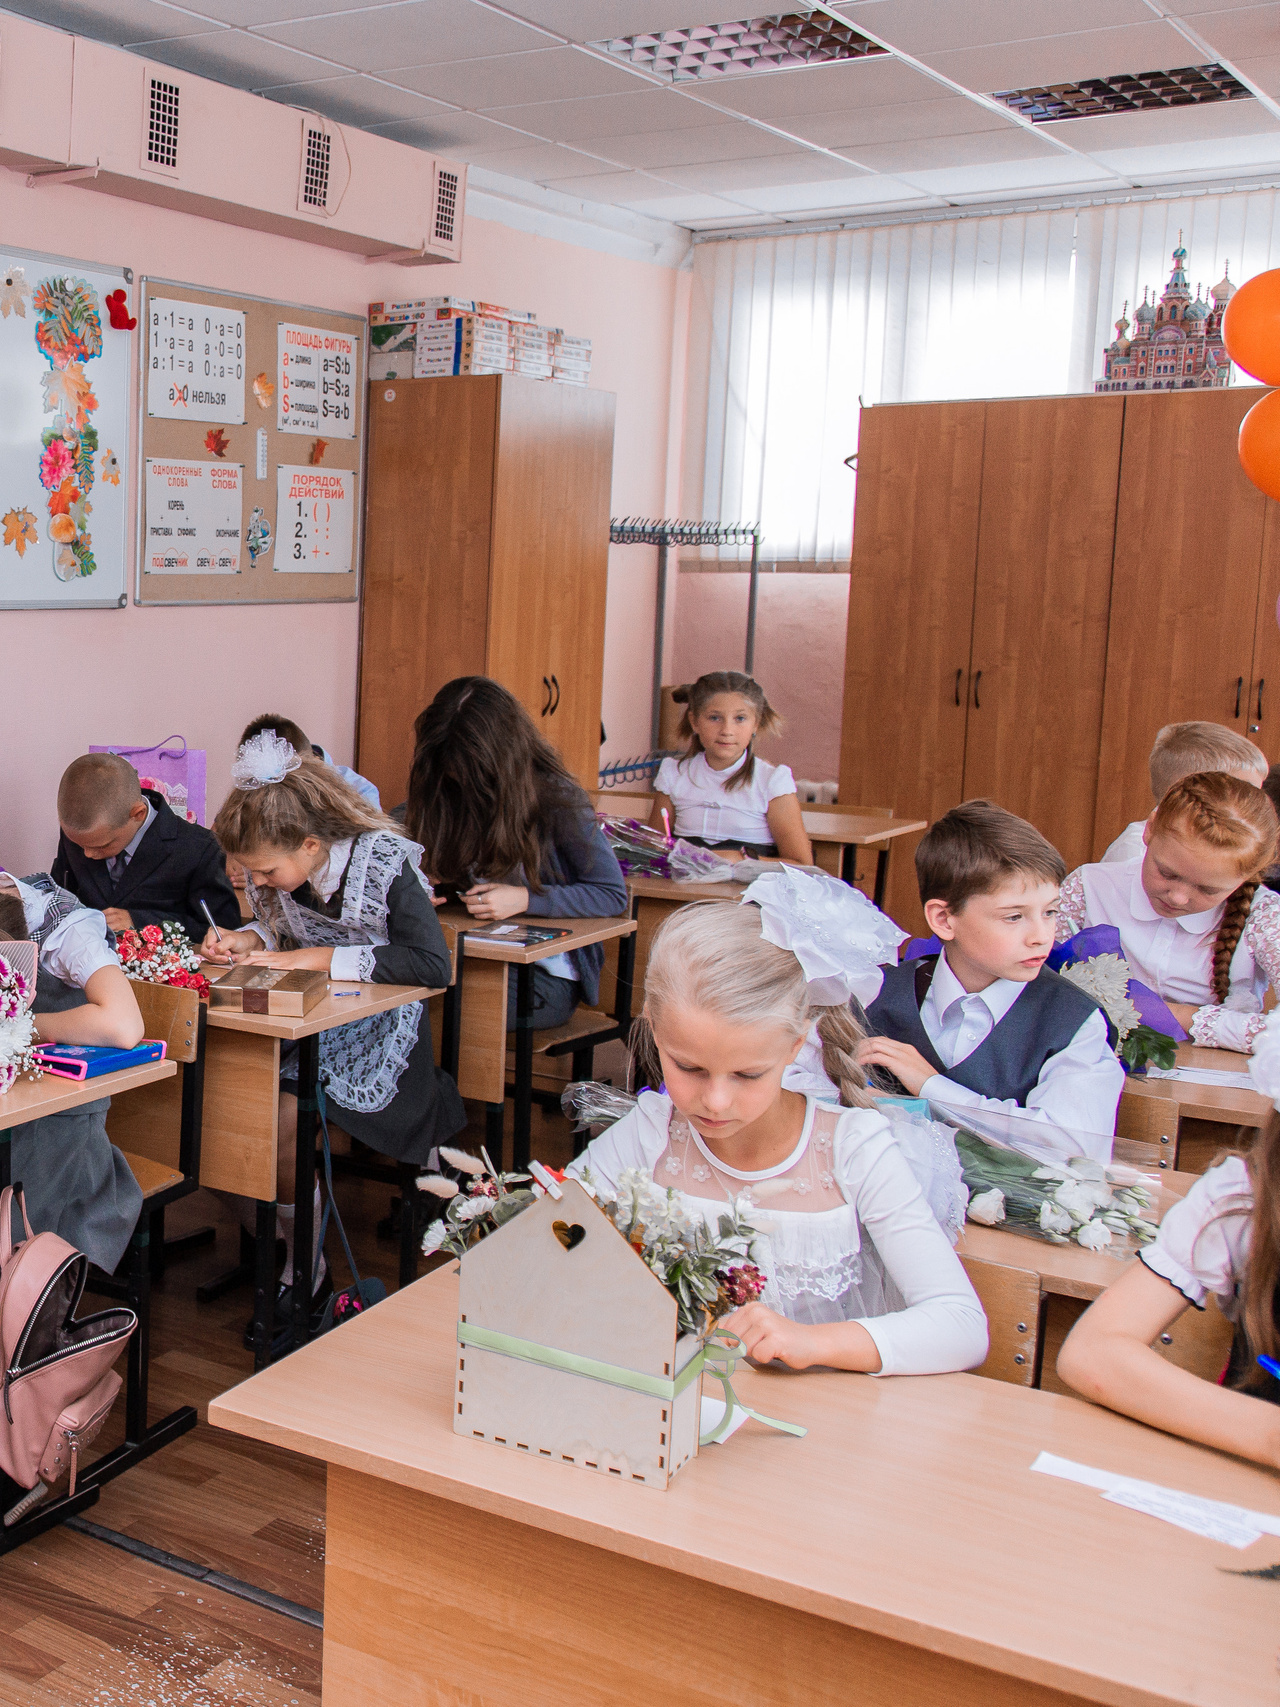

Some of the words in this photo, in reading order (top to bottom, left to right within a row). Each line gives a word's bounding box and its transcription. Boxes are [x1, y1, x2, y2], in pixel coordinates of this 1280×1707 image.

[384, 313, 410, 323] Puzzle
[286, 330, 322, 351] ПЛОЩАДЬ
[324, 336, 352, 354] ФИГУРЫ
[295, 354, 312, 366] длина
[283, 371, 290, 389] b
[295, 379, 316, 390] ширина
[192, 390, 227, 406] нельзя
[282, 394, 290, 413] S
[295, 402, 319, 414] площадь
[152, 465, 203, 477] ОДНОКОРЕННЫЕ
[210, 468, 239, 479] ФОРМА
[167, 477, 189, 487] СЛОВА
[211, 479, 237, 489] СЛОВА
[292, 474, 342, 488] ПОРЯДОК
[288, 486, 345, 500] ДЕЙСТВИЙ
[167, 500, 185, 510] КОРЕНЬ
[150, 527, 173, 536] ПРИСТАВКА
[177, 528, 197, 537] СУФФИКС
[215, 529, 240, 538] ОКОНЧАНИЕ
[152, 557, 189, 568] ПОДСВЕЧНИК
